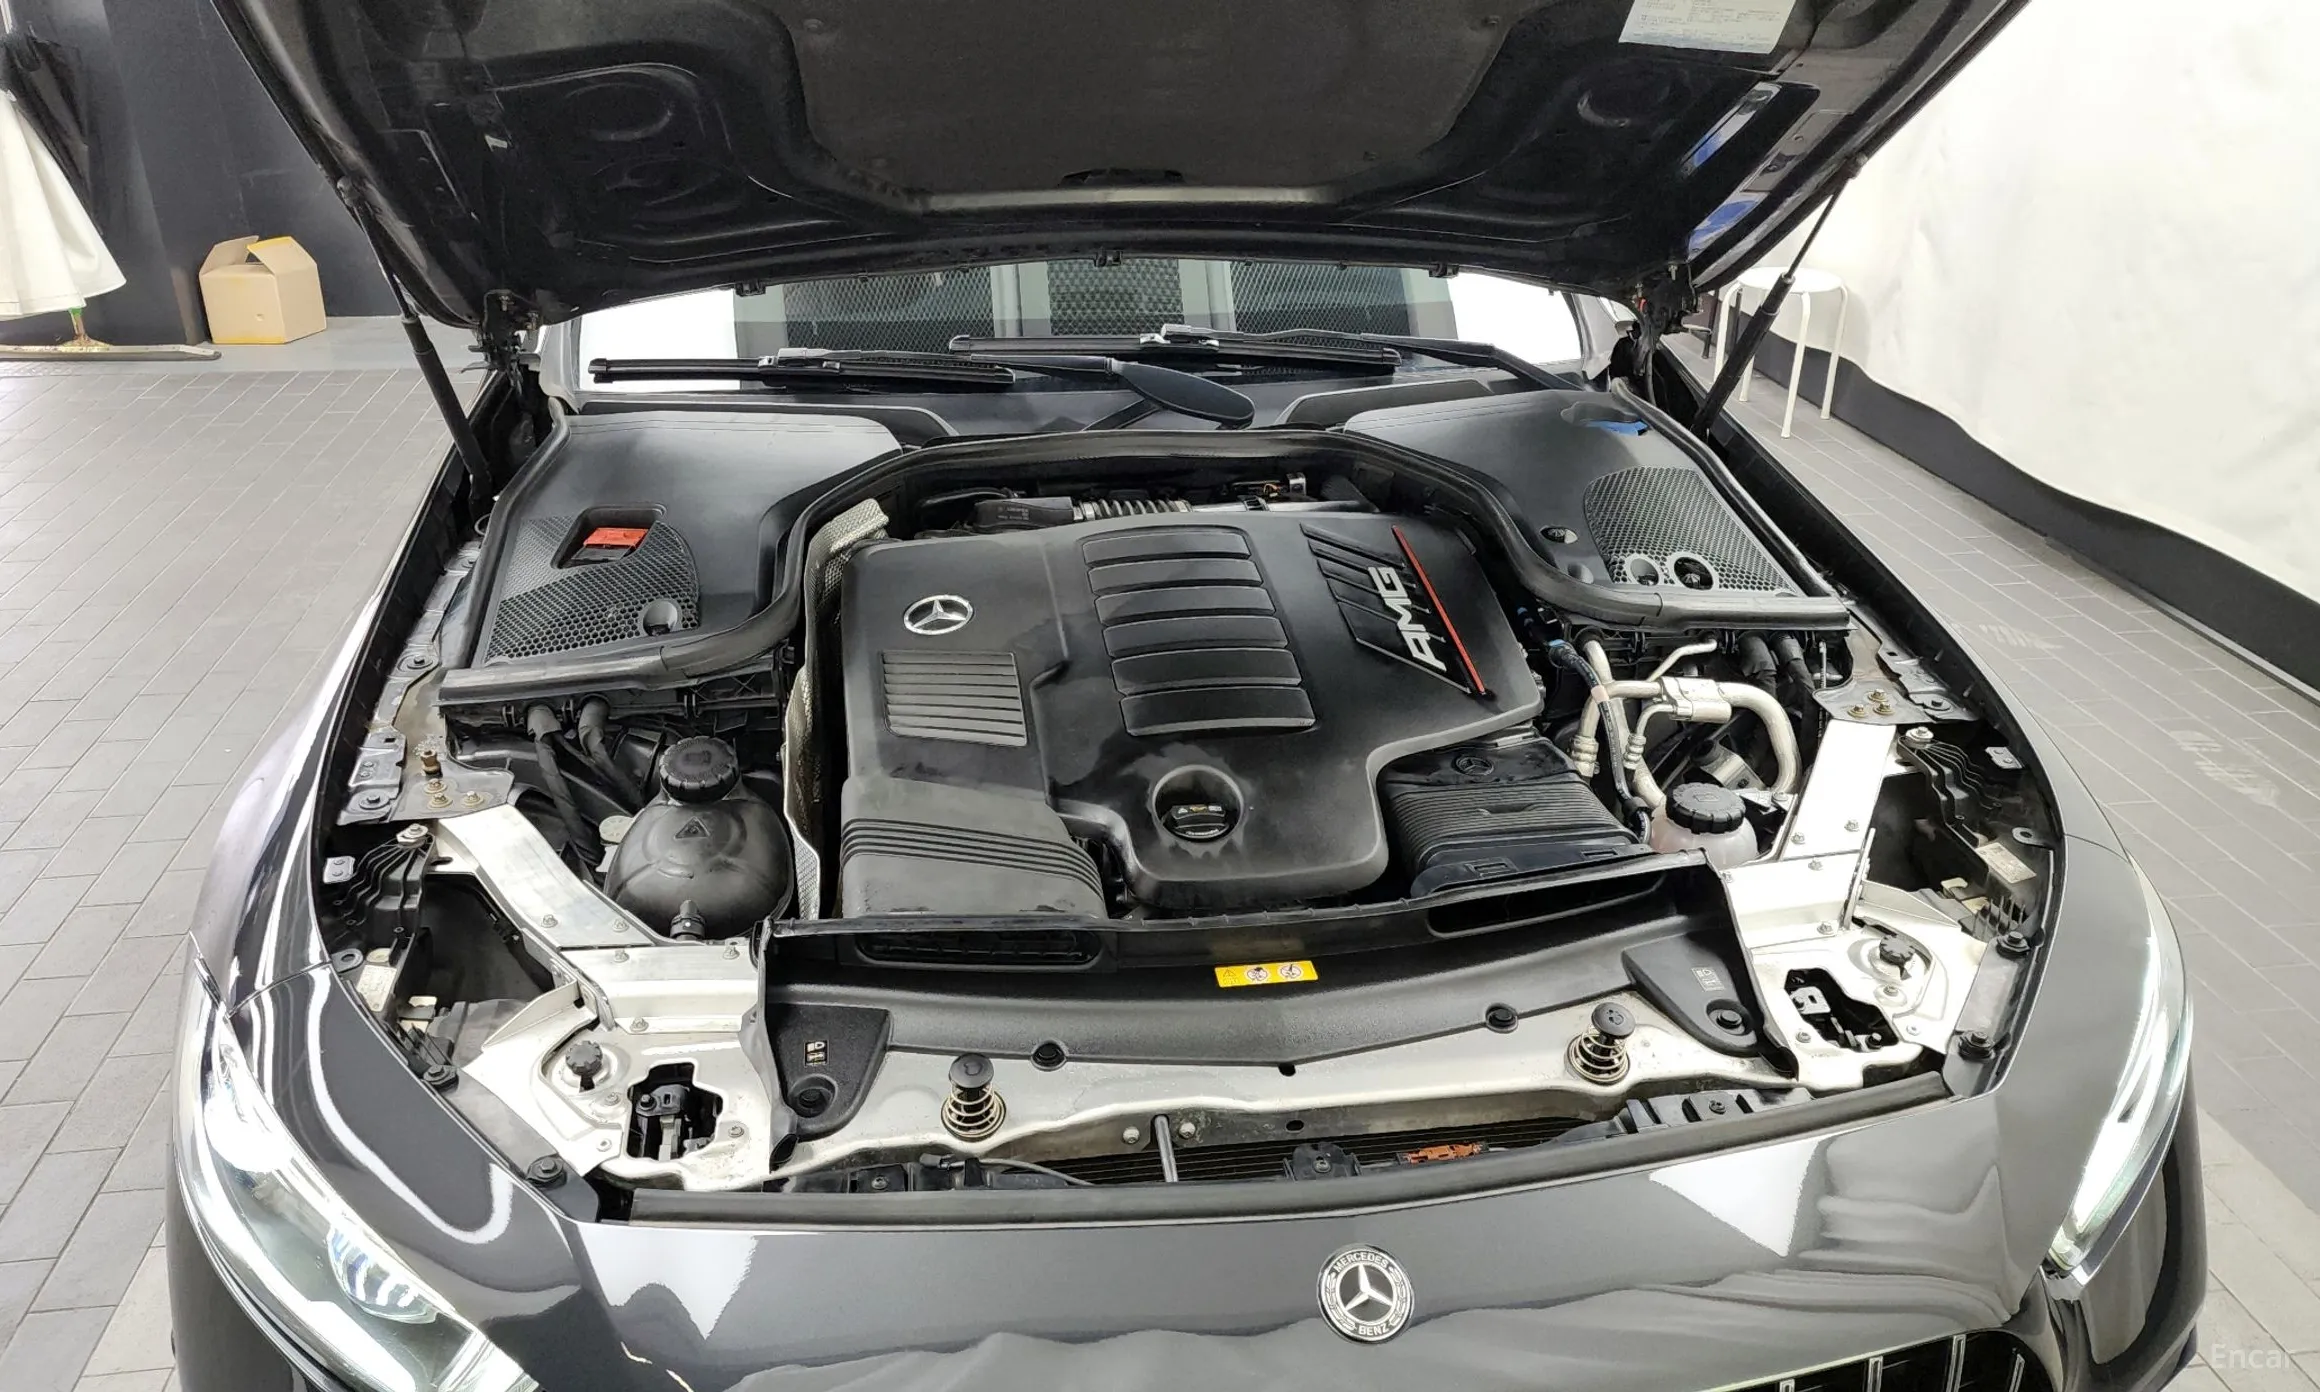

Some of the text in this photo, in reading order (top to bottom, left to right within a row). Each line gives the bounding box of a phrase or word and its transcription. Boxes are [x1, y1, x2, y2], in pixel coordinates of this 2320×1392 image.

[1368, 567, 1447, 672] AMG
[1333, 1251, 1389, 1273] MERCEDES
[1358, 1323, 1390, 1336] BENZ
